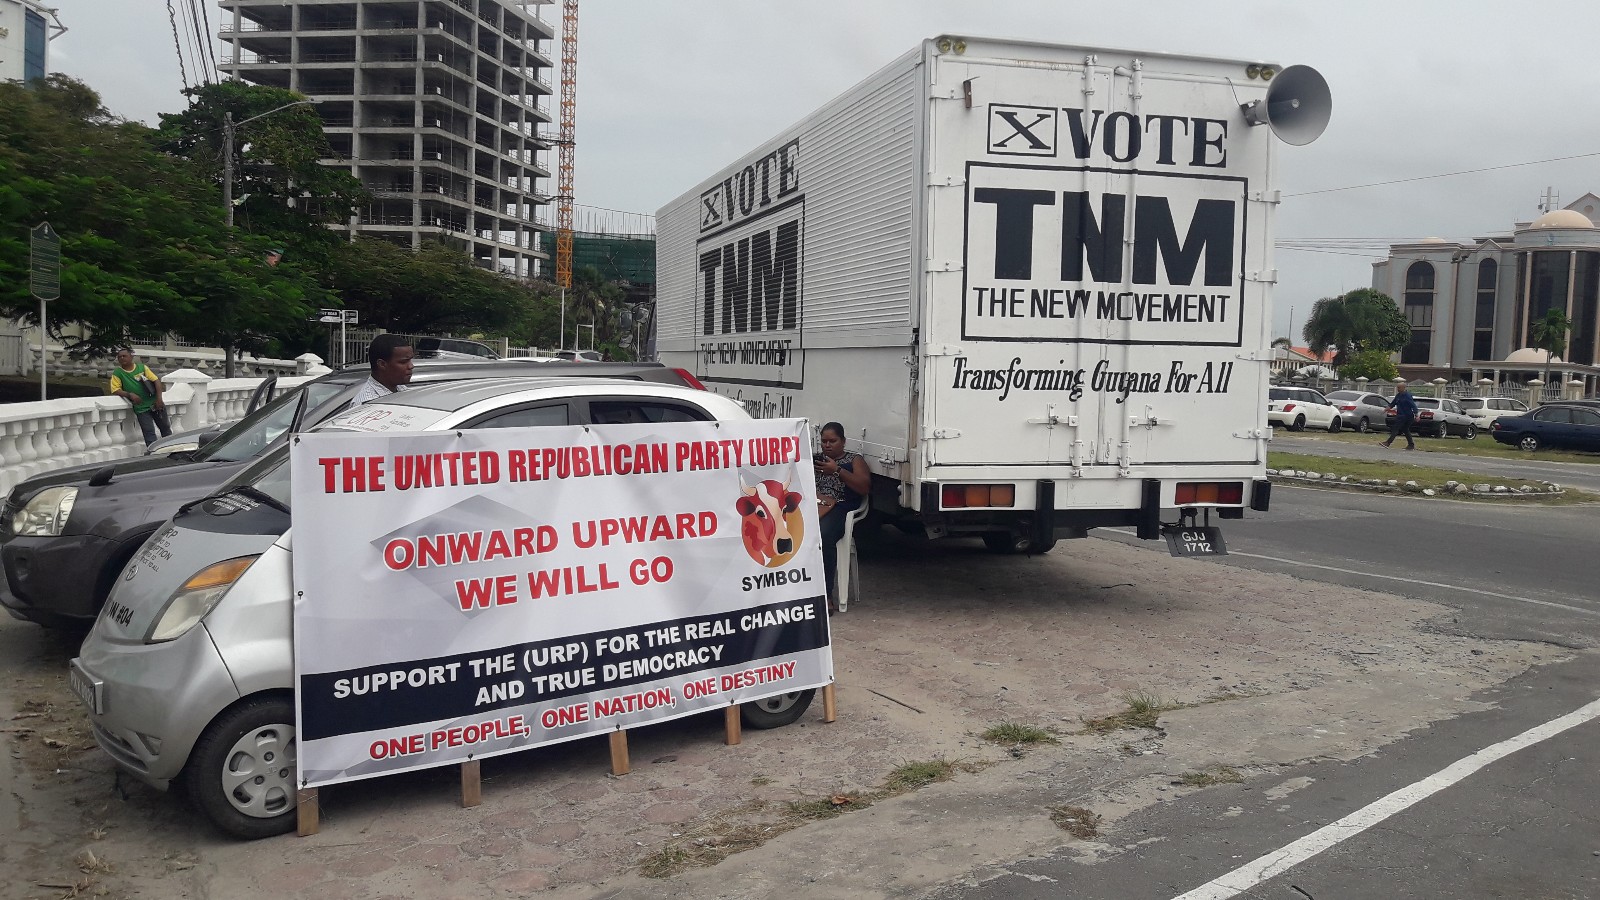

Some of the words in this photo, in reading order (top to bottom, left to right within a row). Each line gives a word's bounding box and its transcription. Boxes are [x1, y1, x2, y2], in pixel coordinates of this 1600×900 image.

[1062, 108, 1227, 168] VOTE
[724, 137, 799, 221] VOTE
[974, 187, 1235, 286] TNM
[700, 219, 798, 335] TNM
[973, 287, 1024, 318] THE
[1030, 288, 1091, 318] NEW
[1096, 290, 1230, 322] MOVEMENT
[701, 343, 716, 364] THE
[718, 342, 737, 365] NEW
[739, 339, 792, 367] MOVEMENT
[952, 357, 1086, 402] Transforming
[1091, 360, 1162, 404] Guyana
[1164, 361, 1198, 393] For
[1196, 361, 1233, 393] All
[318, 456, 386, 494] THE
[394, 451, 500, 491] UNITED
[508, 442, 669, 483] REPUBLICAN
[675, 437, 744, 472] PARTY
[383, 524, 559, 571] ONWARD
[572, 511, 719, 549] UPWARD
[1182, 532, 1206, 541] GJJ
[1184, 542, 1212, 552] 1712
[455, 575, 518, 611] WE
[527, 562, 620, 600] WILL
[629, 556, 674, 586] GO
[741, 567, 812, 592] SYMBOL
[333, 662, 461, 699] SUPPORT
[469, 653, 516, 678] THE
[523, 641, 589, 672] (URP)
[595, 633, 639, 657] FOR
[643, 626, 681, 647] THE
[685, 617, 736, 641] REAL
[740, 603, 816, 632] CHANGE
[474, 681, 525, 707] AND
[532, 667, 596, 695] TRUE
[602, 644, 725, 681] DEMOCRACY
[369, 734, 426, 760] ONE
[431, 714, 531, 751] PEOPLE,
[541, 702, 590, 730] ONE
[594, 687, 677, 719] NATION,
[683, 677, 718, 701] ONE
[721, 660, 797, 693] DESTINY
